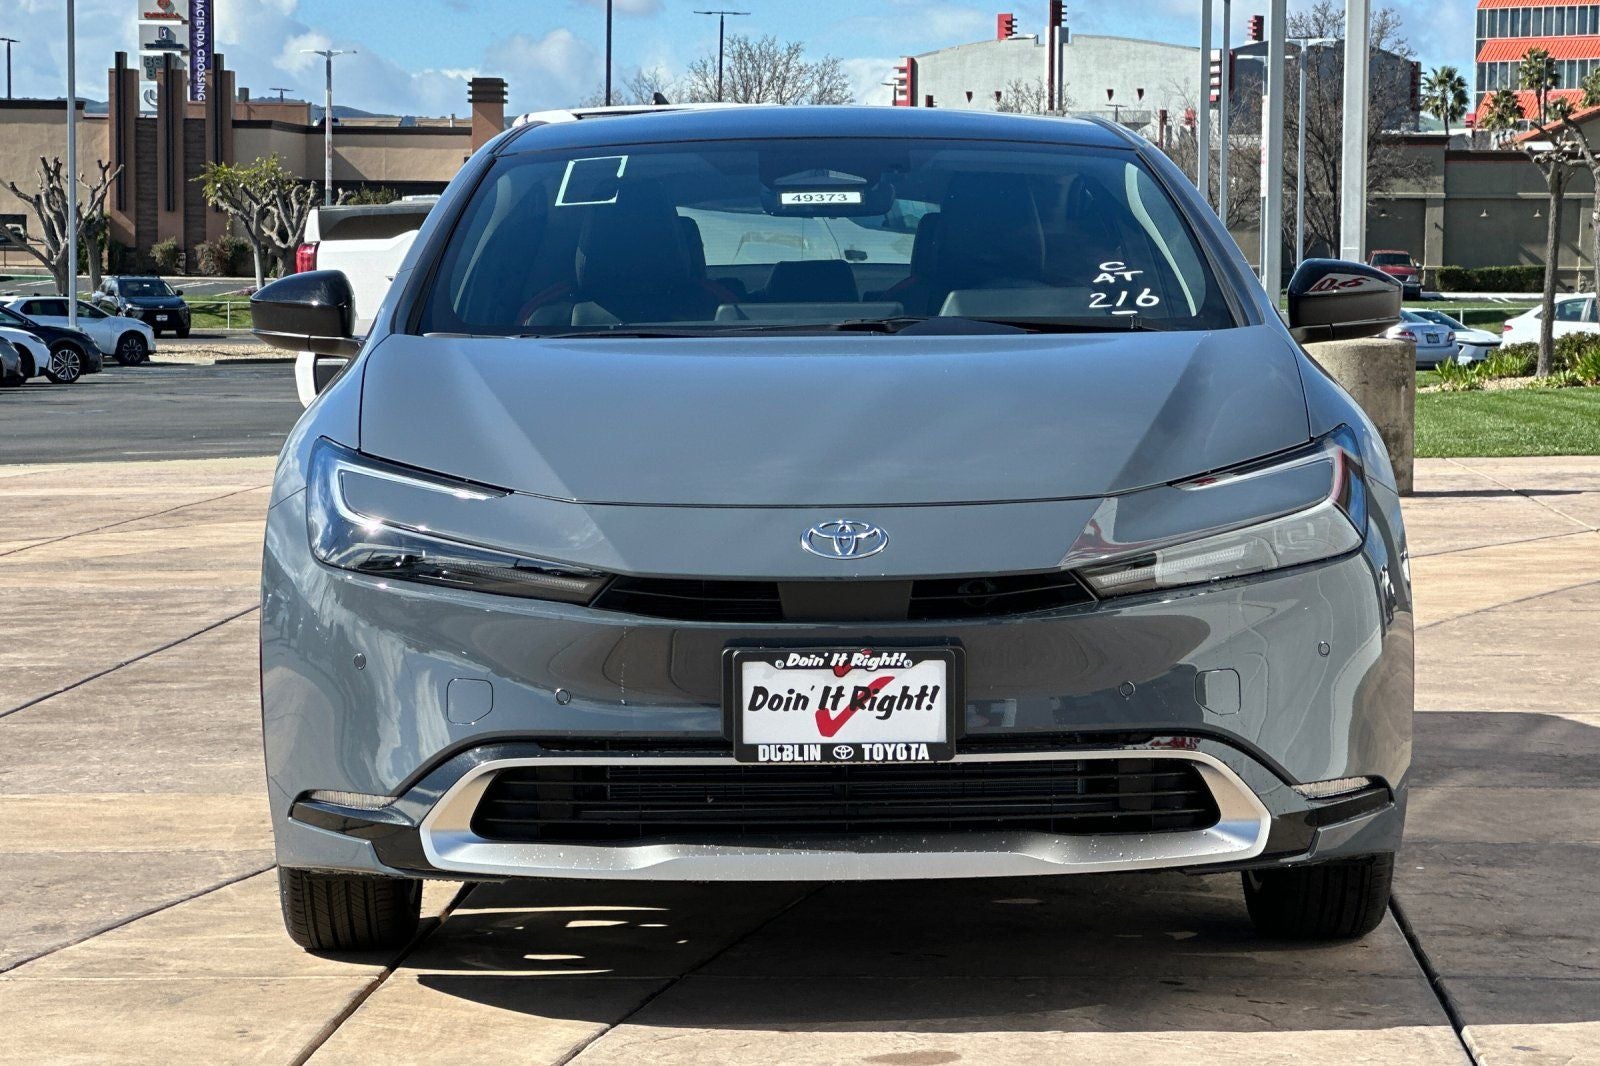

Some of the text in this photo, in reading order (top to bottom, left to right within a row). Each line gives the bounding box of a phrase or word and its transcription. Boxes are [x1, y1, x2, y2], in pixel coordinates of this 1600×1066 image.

[197, 49, 206, 101] CROSSING
[791, 193, 848, 202] 49373
[1088, 287, 1160, 308] 216
[786, 652, 907, 671] Doin' It Right!
[747, 685, 941, 720] Doin' It Right!
[758, 743, 930, 762] DUBLIN TOYOTA
